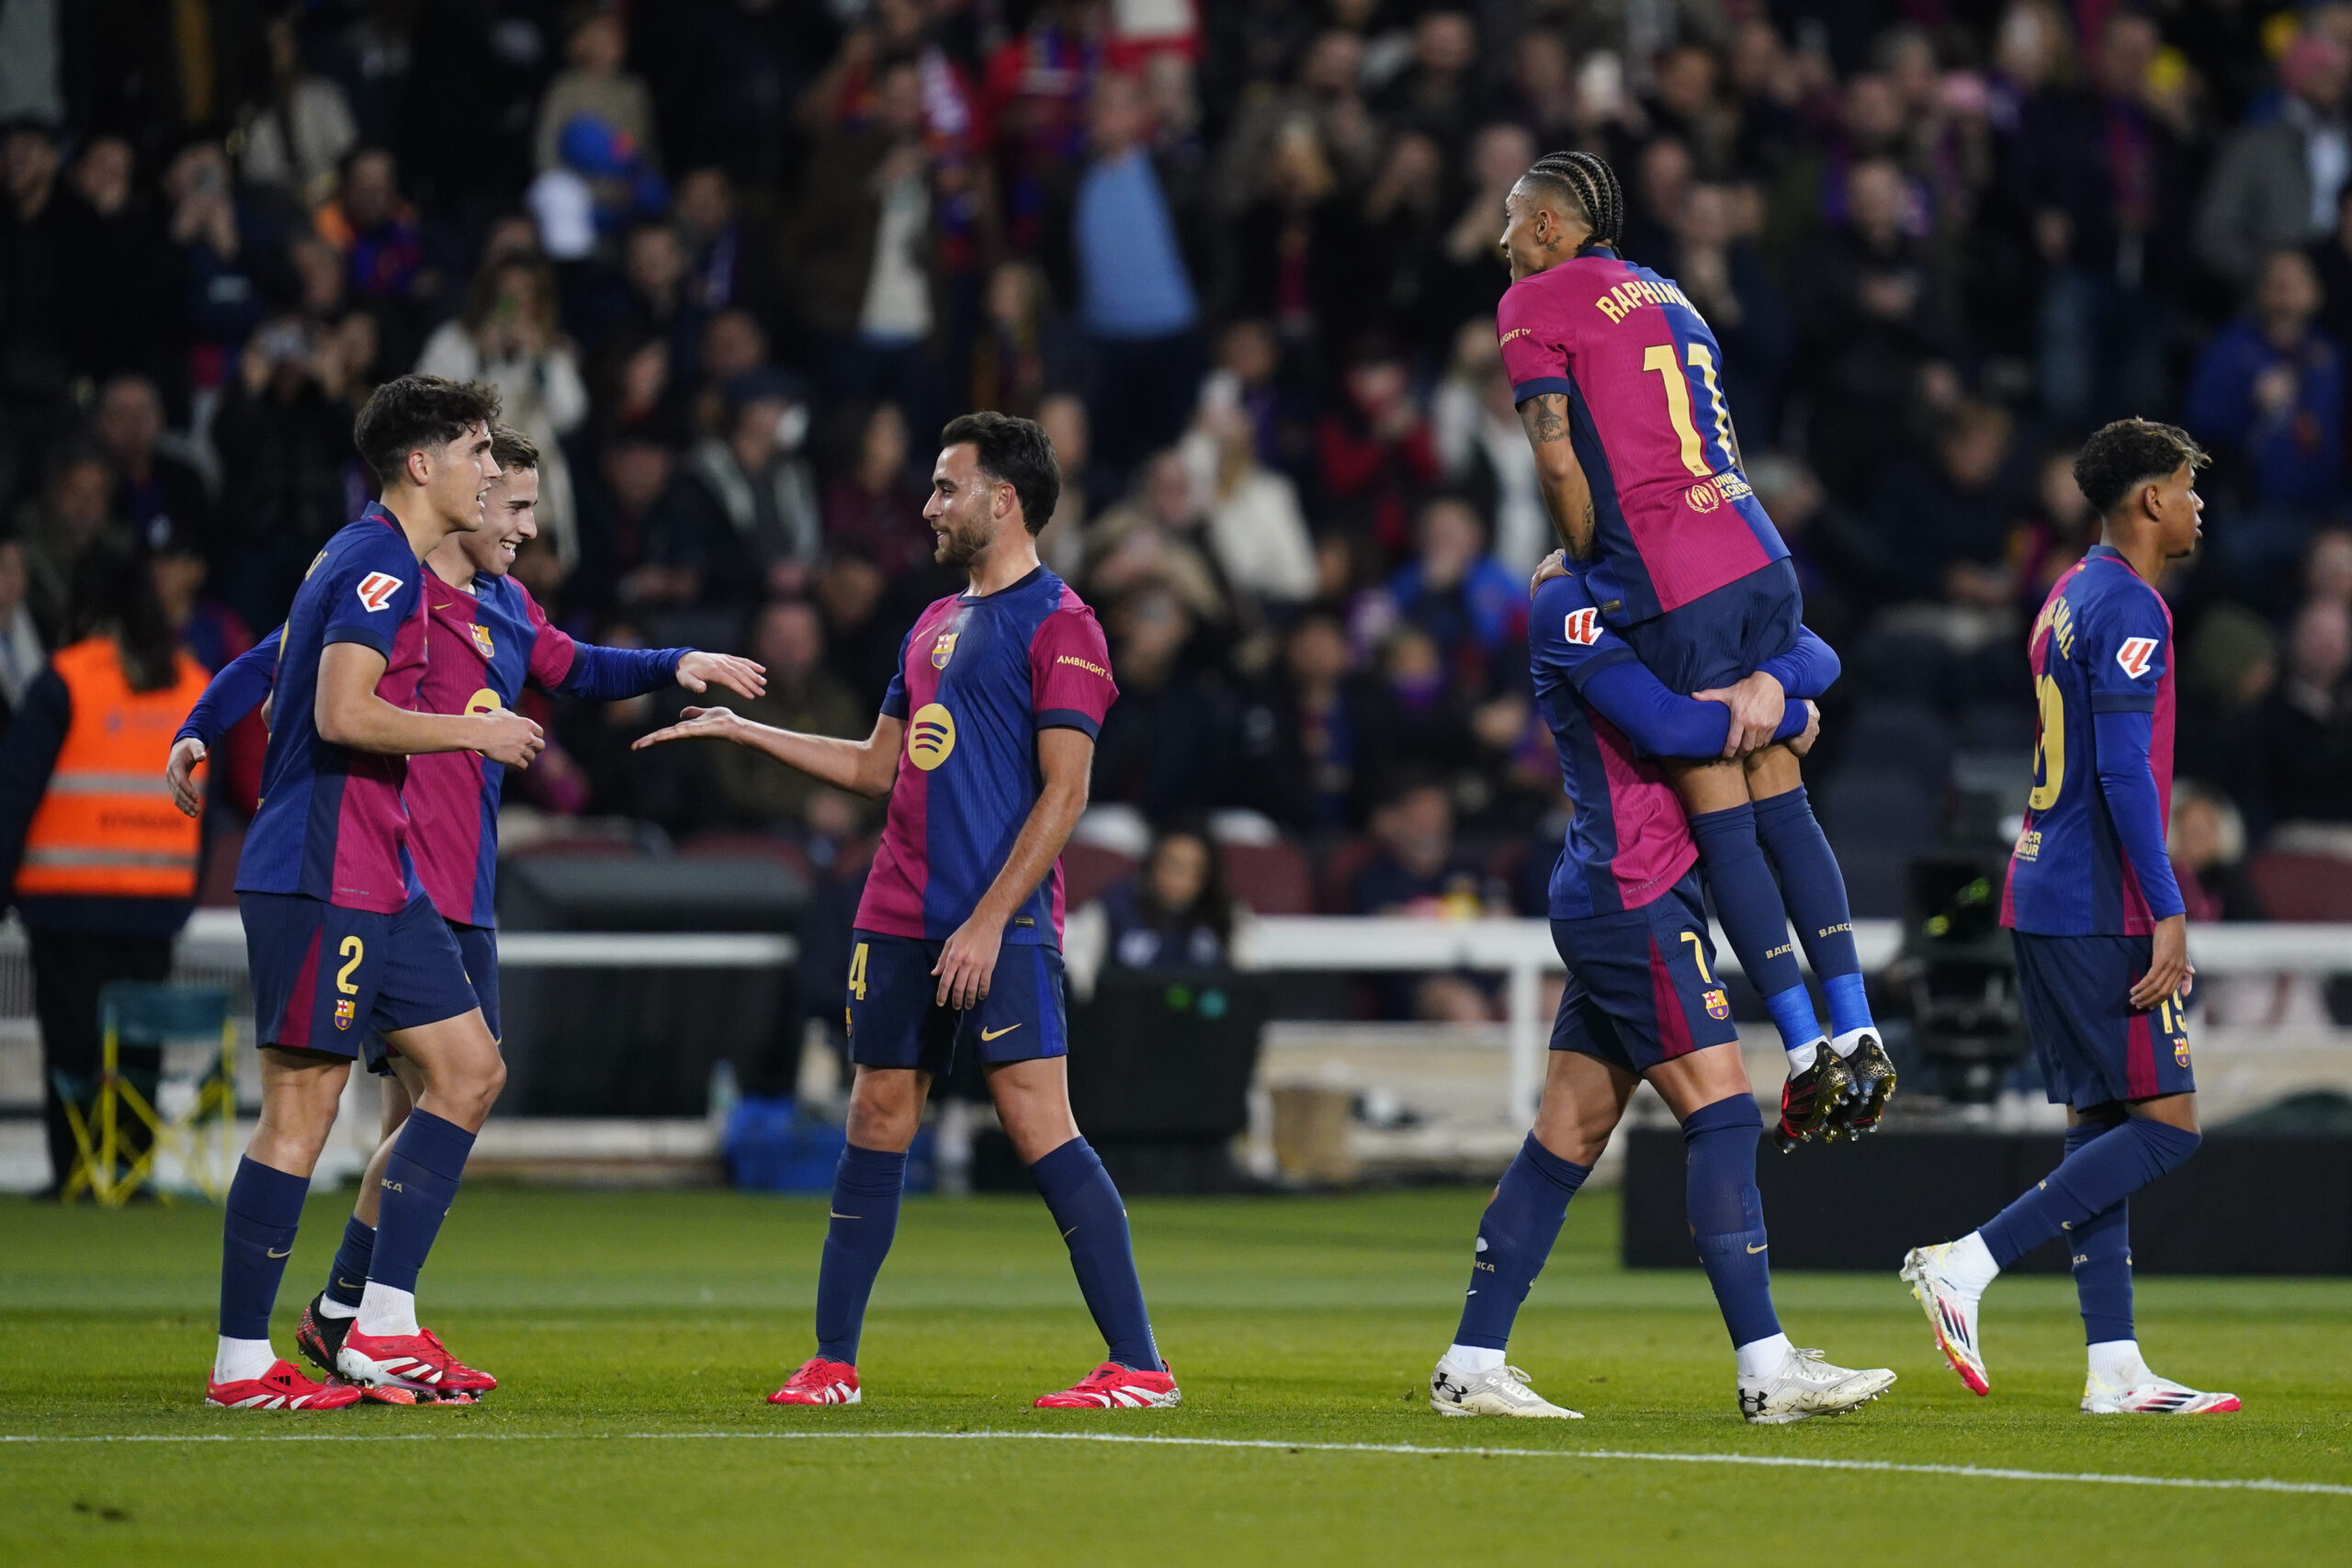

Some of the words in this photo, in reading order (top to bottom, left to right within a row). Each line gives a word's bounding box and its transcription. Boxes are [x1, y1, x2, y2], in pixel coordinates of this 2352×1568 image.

[1595, 281, 1708, 327] RAPHIN
[1643, 343, 1736, 478] 11
[1057, 655, 1107, 677] AMBILIGHT
[336, 935, 364, 996] 2
[848, 942, 869, 1001] 4
[1679, 931, 1713, 984] 7
